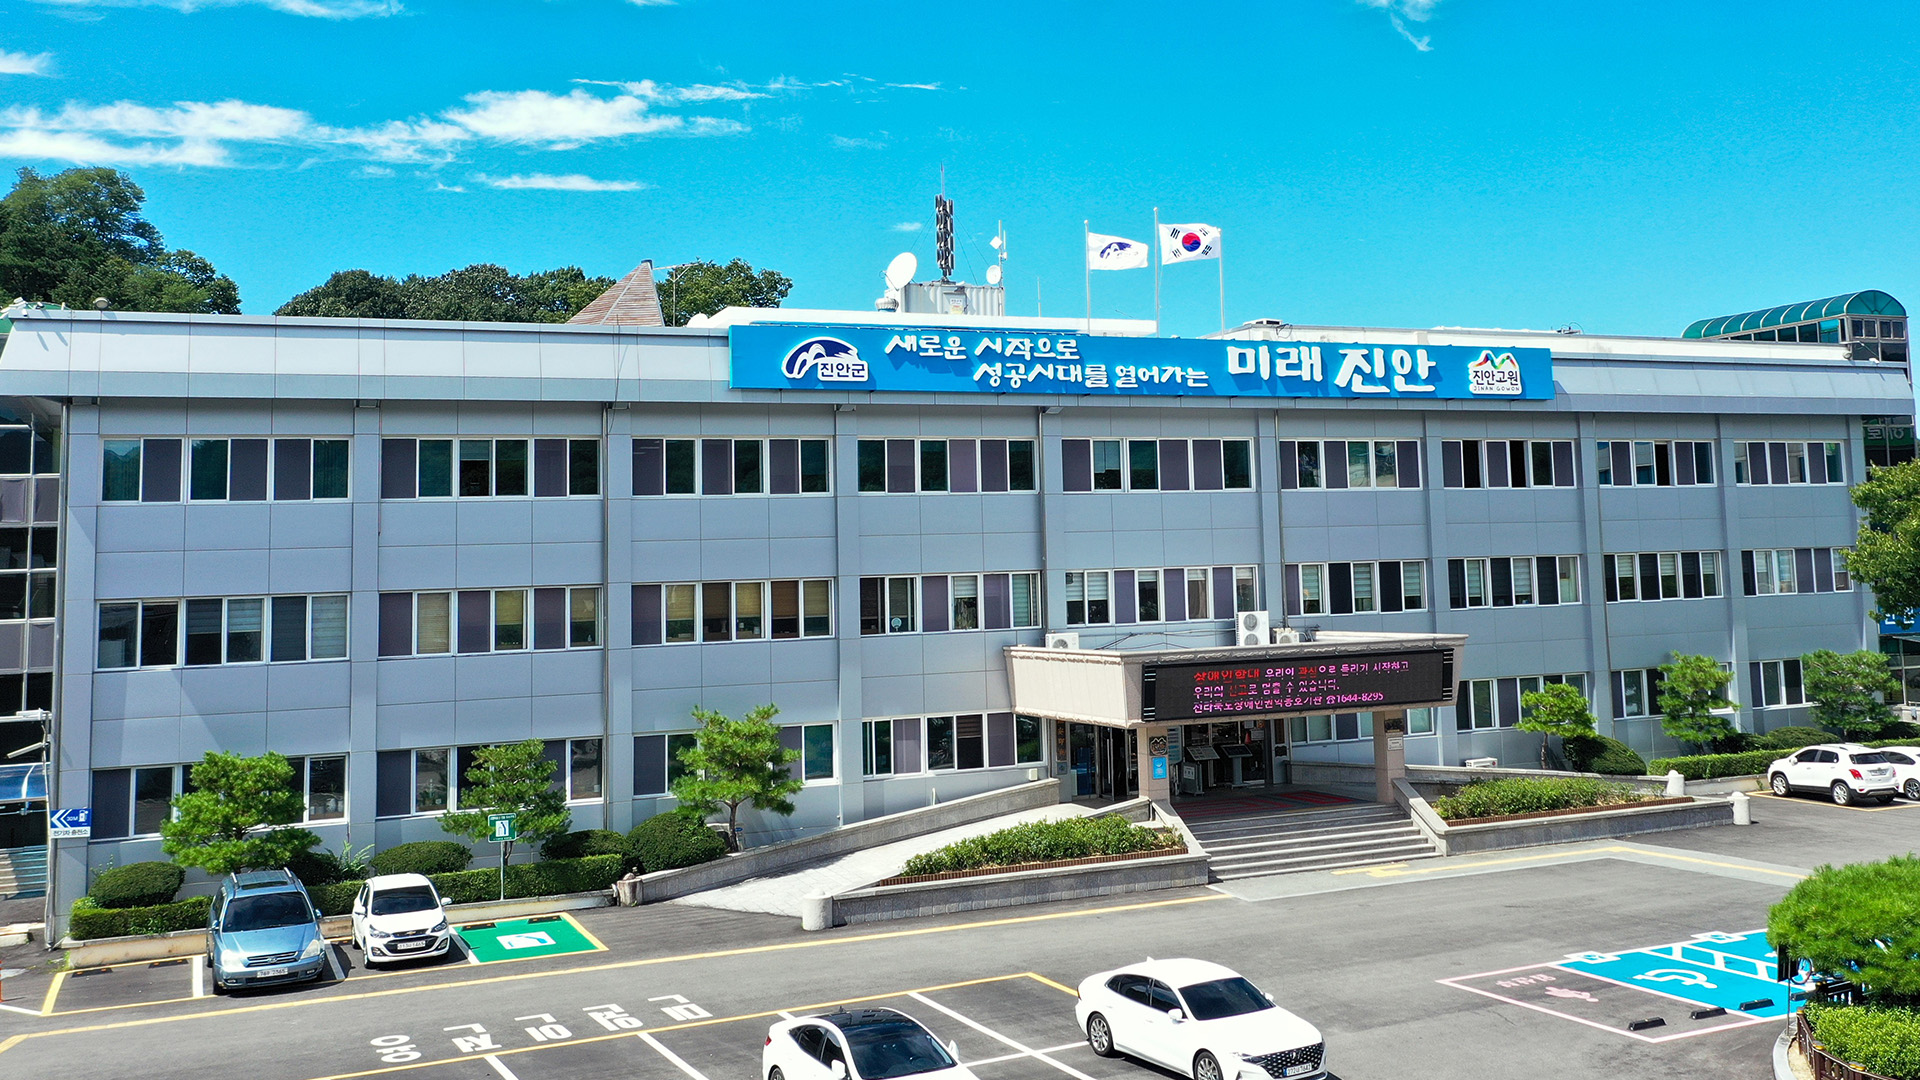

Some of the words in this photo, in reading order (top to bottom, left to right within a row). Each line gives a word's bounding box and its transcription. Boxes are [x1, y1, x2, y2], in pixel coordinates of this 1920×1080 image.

[884, 334, 968, 360] 새로운
[974, 336, 1081, 361] 시작으로
[820, 362, 866, 378] 진안군
[973, 362, 1110, 389] 성공시대를
[1115, 365, 1210, 388] 열어가는
[1226, 345, 1322, 383] 미래
[1334, 347, 1437, 393] 진안
[1472, 370, 1519, 386] 진안고원
